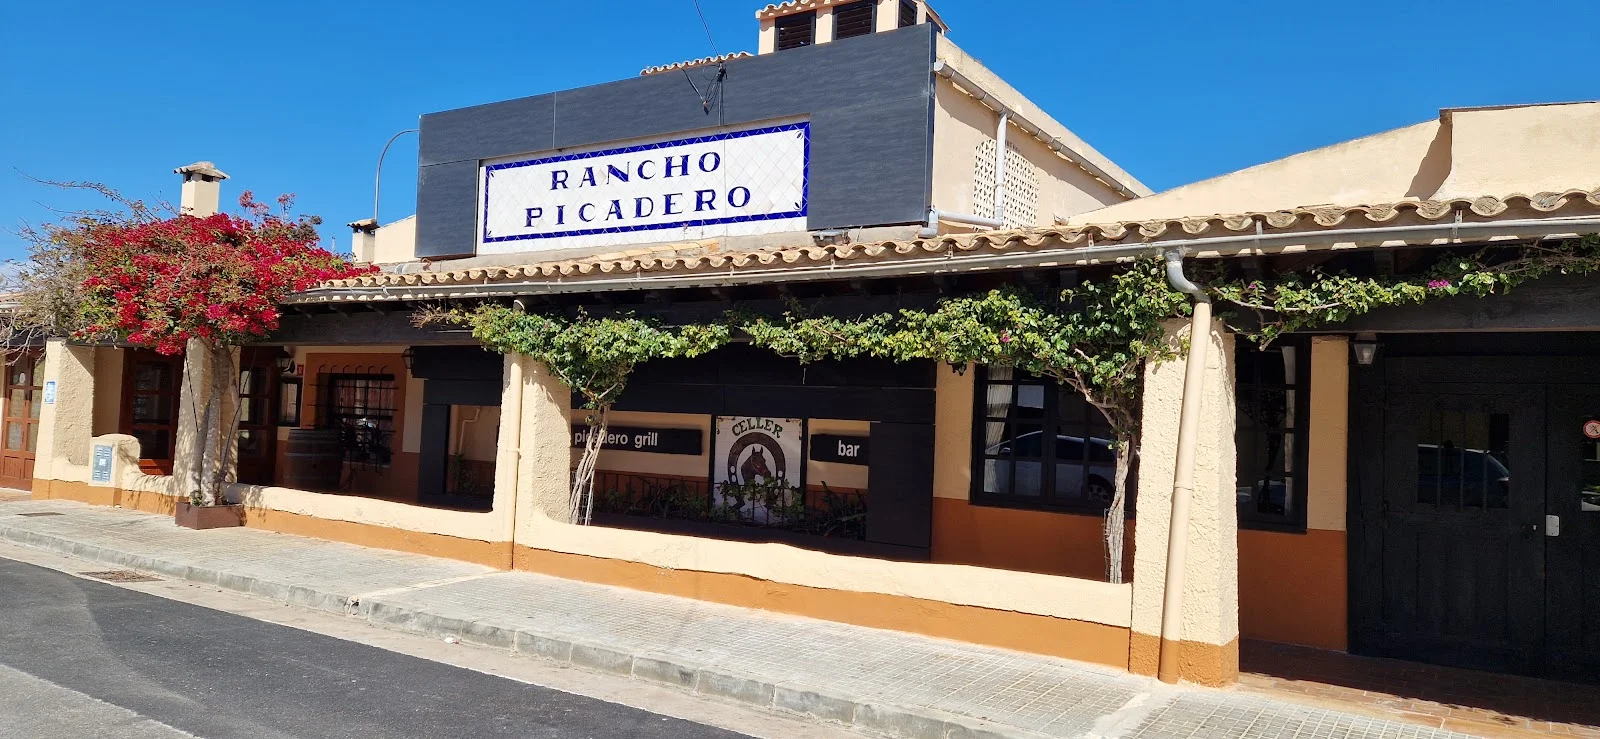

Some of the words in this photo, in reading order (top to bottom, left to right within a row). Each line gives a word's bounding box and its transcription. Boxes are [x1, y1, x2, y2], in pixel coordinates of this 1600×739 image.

[550, 151, 721, 190] RANCHO
[525, 186, 750, 227] PICADERO
[732, 417, 783, 438] CELLER
[634, 431, 658, 448] grill
[838, 440, 860, 457] bar
